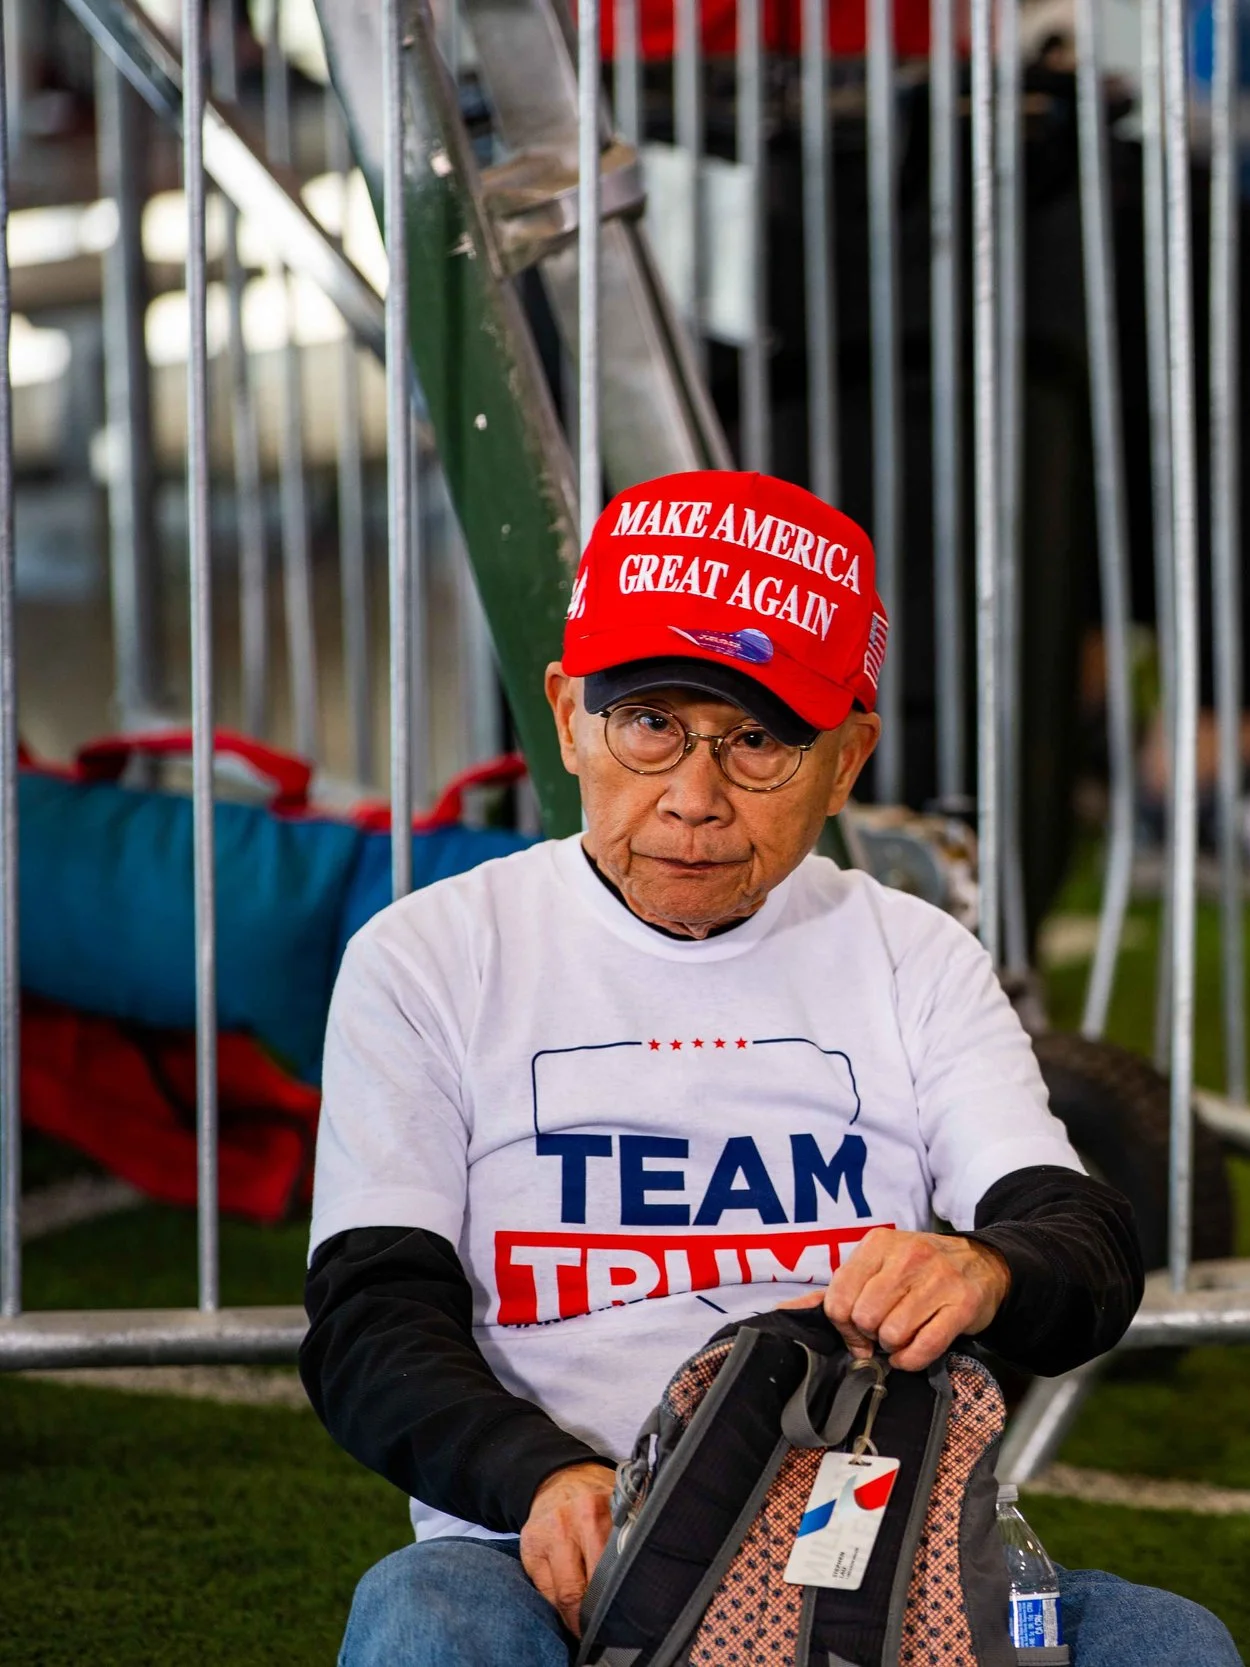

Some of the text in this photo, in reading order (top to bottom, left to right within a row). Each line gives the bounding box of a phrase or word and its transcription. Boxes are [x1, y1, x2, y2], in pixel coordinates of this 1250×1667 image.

[610, 500, 862, 596] MAKE AMERICA
[618, 553, 730, 600] GREAT
[726, 569, 839, 642] AGAIN
[536, 1133, 872, 1226] TEAM
